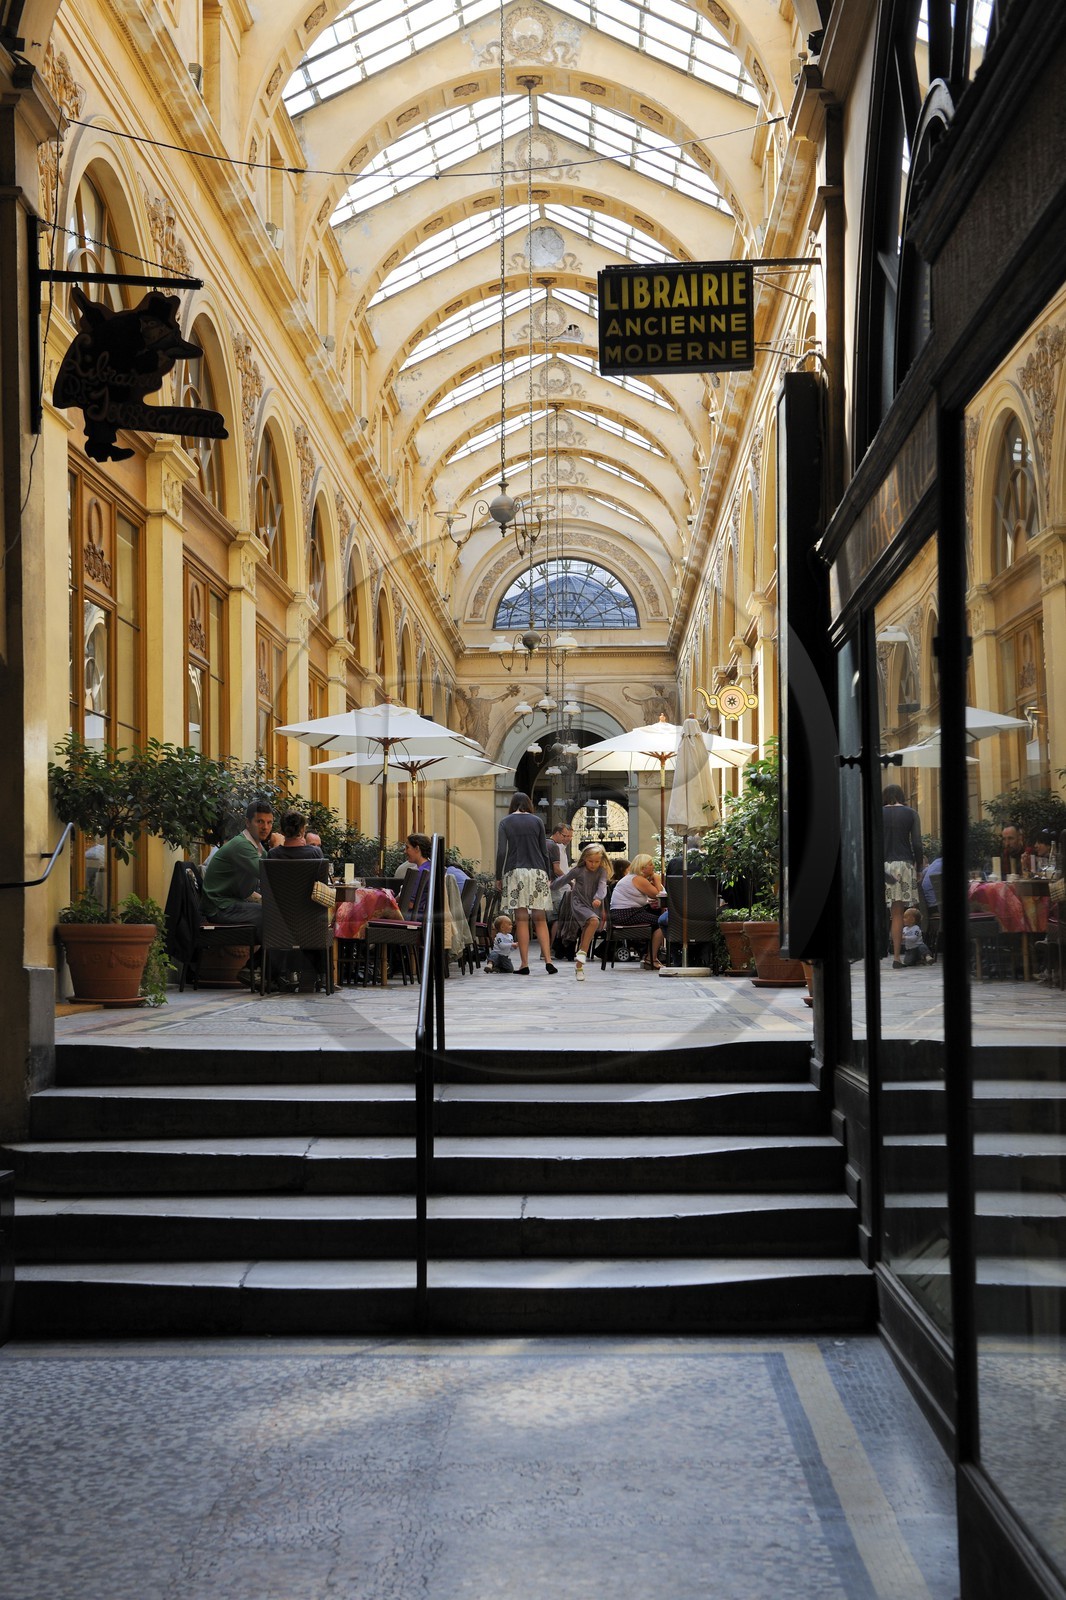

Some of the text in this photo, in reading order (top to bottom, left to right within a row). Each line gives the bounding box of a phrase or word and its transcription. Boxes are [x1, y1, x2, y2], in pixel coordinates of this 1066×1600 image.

[604, 271, 747, 311] LIBRAIRIE
[605, 312, 747, 337] ANCIENNE
[604, 340, 748, 364] MODERNE
